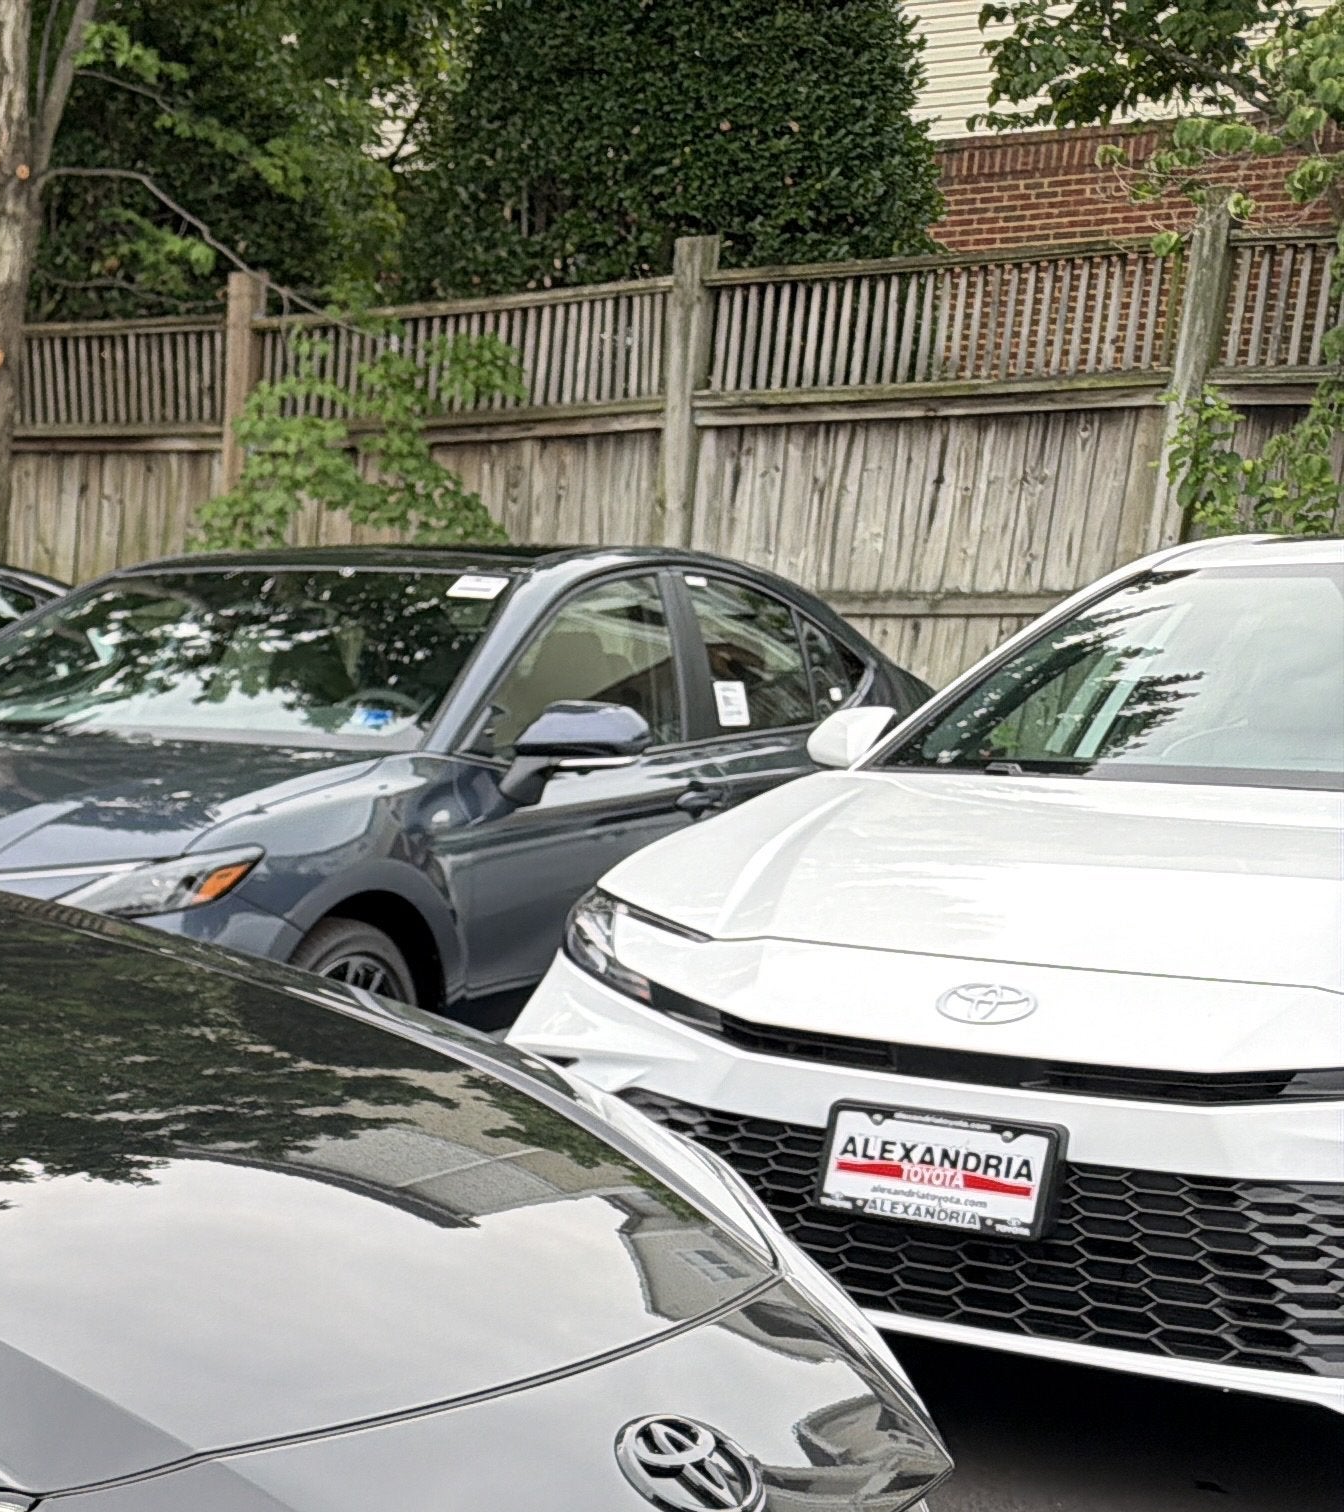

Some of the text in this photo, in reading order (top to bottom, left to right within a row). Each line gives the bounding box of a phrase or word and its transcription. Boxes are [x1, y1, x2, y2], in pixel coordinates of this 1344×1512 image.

[839, 1136, 1034, 1182] ALEXANDRIA
[901, 1165, 965, 1188] TOYOTA
[870, 1185, 988, 1208] alexandriatoyota.com
[868, 1199, 977, 1225] ALEXANDRIA
